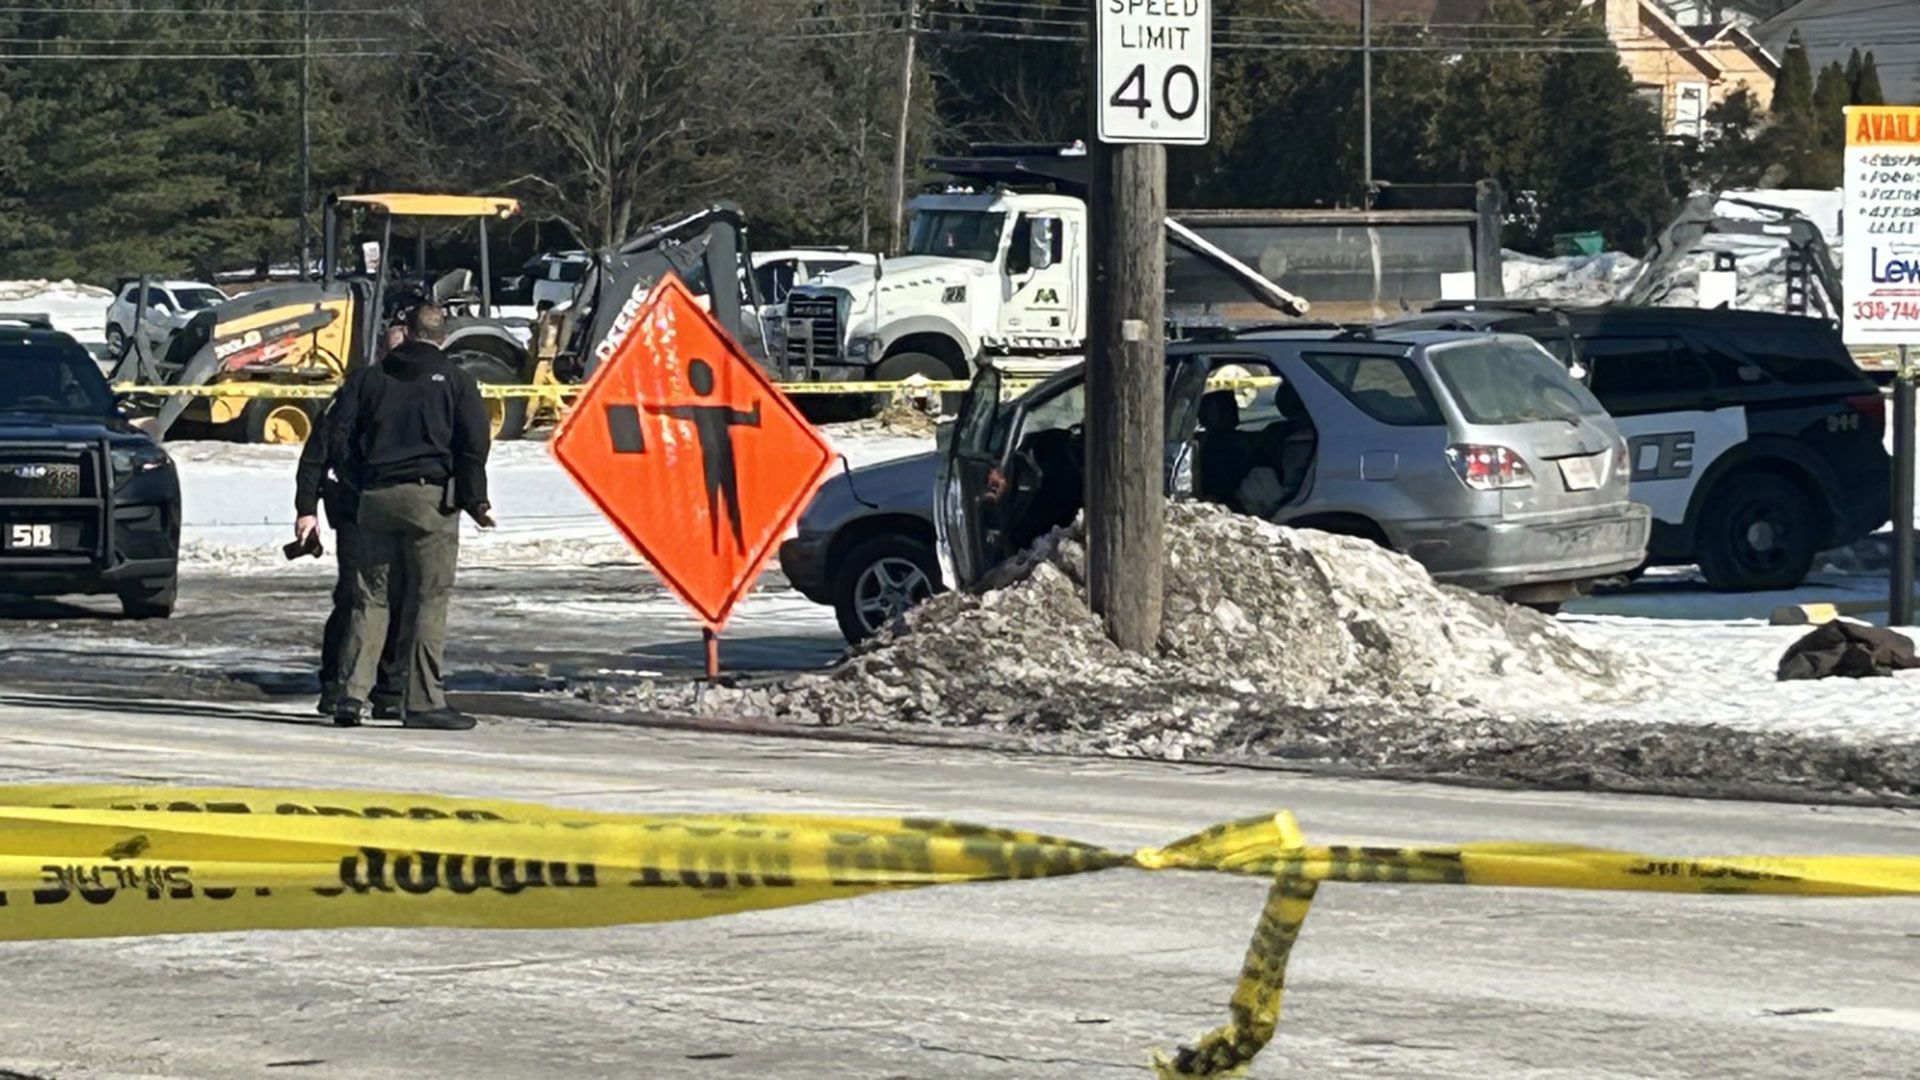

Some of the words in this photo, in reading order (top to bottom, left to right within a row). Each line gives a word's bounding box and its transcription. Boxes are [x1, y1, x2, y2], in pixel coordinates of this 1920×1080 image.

[1110, 0, 1198, 16] SPEED
[1121, 24, 1190, 49] LIMIT
[1110, 63, 1199, 120] 40
[1856, 113, 1920, 142] AVAIL
